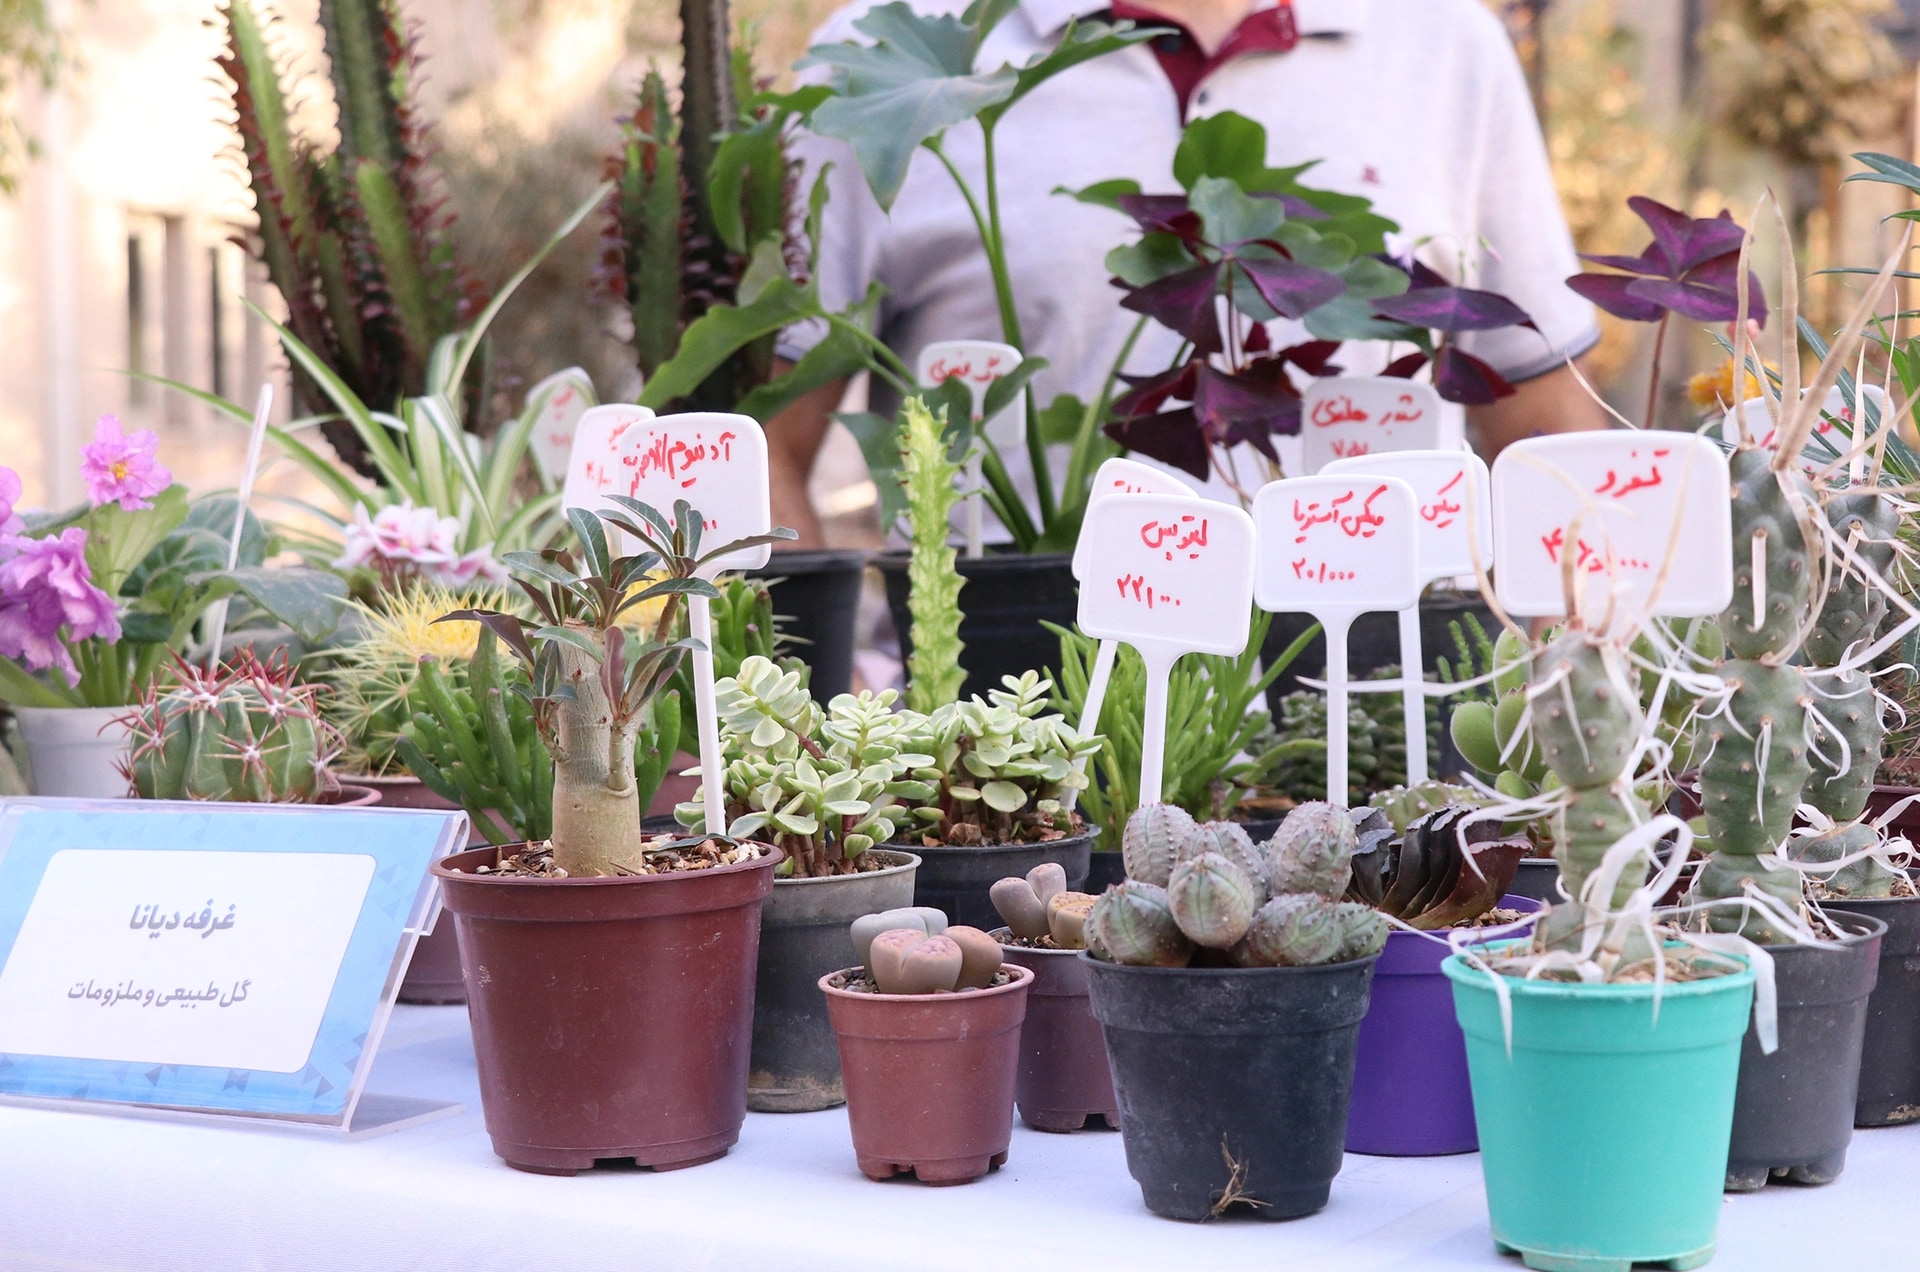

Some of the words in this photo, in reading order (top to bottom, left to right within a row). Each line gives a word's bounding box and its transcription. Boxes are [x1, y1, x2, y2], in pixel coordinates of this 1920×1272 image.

[129, 904, 181, 940] دیانا
[183, 898, 237, 940] غرفه
[155, 980, 220, 1009] طبیعی
[218, 979, 253, 1008] گل
